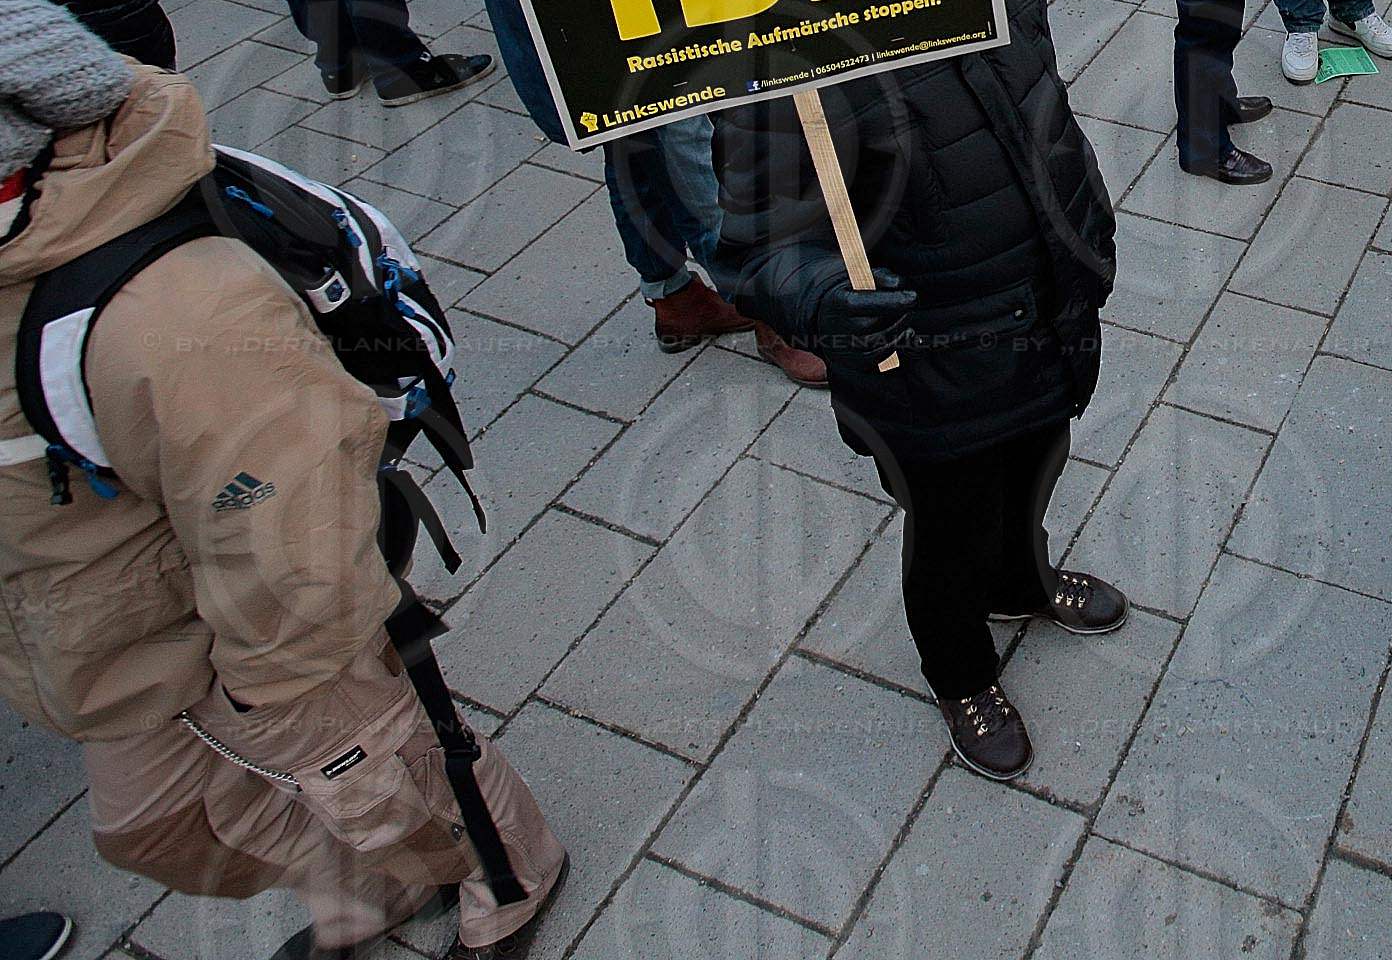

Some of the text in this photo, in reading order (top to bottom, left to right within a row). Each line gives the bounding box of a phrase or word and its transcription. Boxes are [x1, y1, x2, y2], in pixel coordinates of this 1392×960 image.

[602, 84, 727, 129] Linkswende
[815, 54, 870, 76] 06504522473
[876, 30, 988, 60] linkswende@linkswende.org
[626, 38, 743, 74] Rassistische
[746, 10, 861, 50] Aufmärsche
